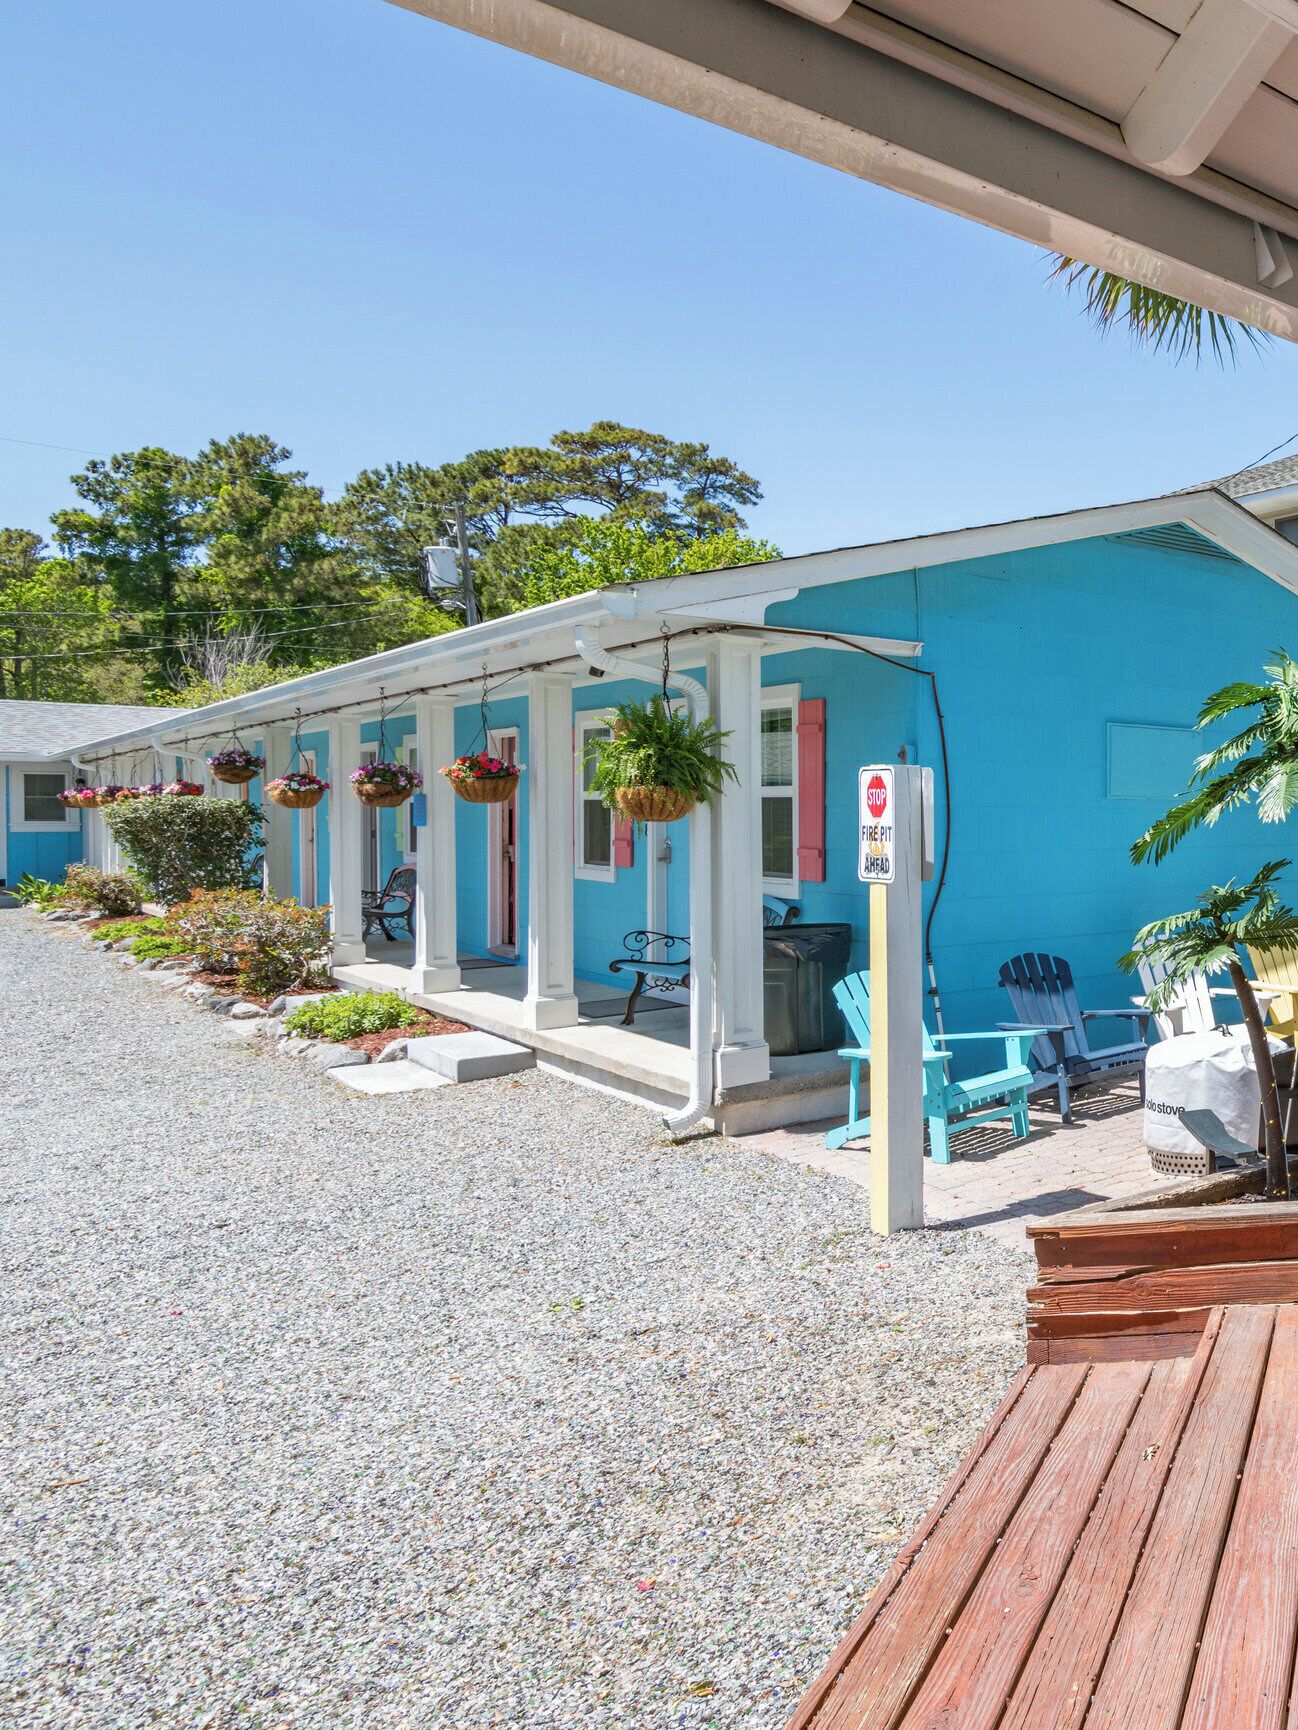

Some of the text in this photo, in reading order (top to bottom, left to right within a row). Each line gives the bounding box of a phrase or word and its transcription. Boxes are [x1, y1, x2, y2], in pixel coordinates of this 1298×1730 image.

[867, 788, 886, 806] STOP
[862, 825, 893, 843] FIRE PIT
[864, 856, 890, 874] AHEAD
[1157, 1102, 1186, 1116] stove
